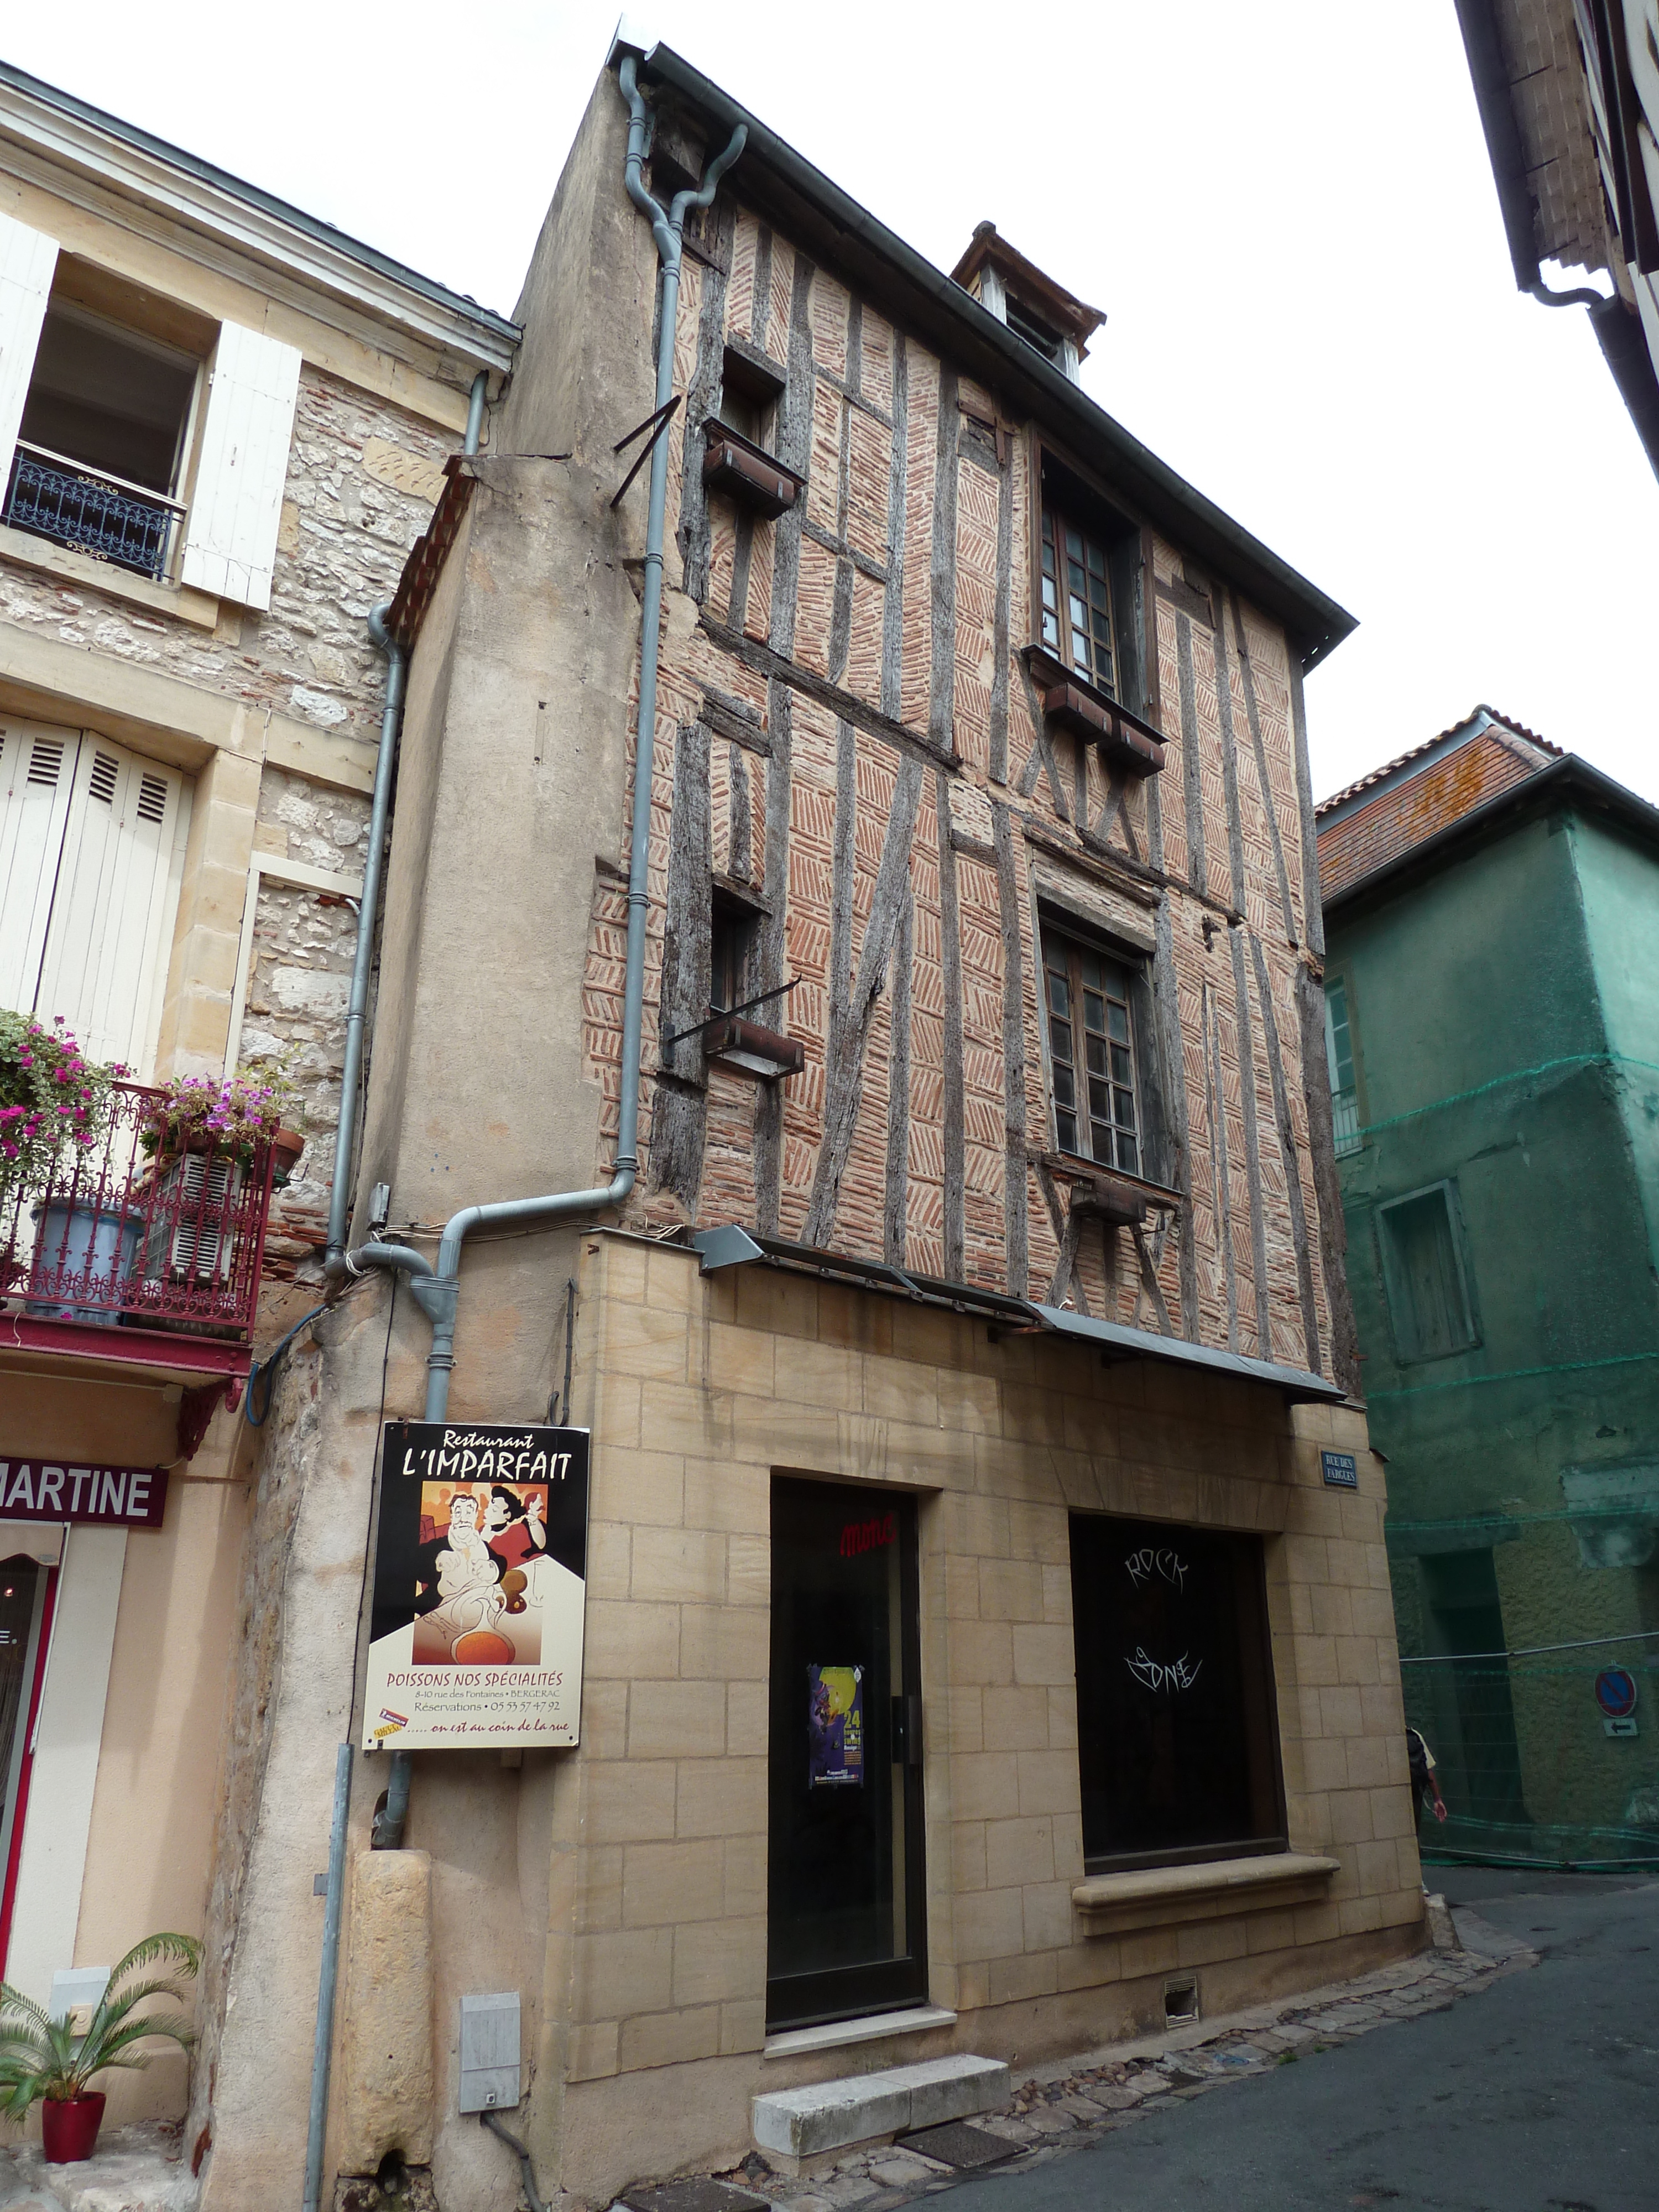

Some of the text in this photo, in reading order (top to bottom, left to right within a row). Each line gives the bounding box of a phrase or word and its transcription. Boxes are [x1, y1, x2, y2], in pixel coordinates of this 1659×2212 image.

[444, 1430, 534, 1449] Restaurant
[403, 1448, 572, 1480] L'IMPARFAIT
[1325, 1455, 1352, 1468] RUE DES
[1327, 1468, 1355, 1481] FARGUES
[1125, 1548, 1188, 1594] ROCK
[387, 1670, 564, 1687] POISSONS NOS SPÉCIALITÉS
[449, 1688, 464, 1698] des
[466, 1690, 504, 1698] Fontaines
[415, 1702, 560, 1713] Réservations 05 53 57 47 92
[449, 1721, 468, 1733] est
[488, 1721, 515, 1732] coin
[518, 1718, 531, 1731] de
[533, 1718, 547, 1731] la
[549, 1723, 570, 1731] rue
[843, 1710, 860, 1729] 24
